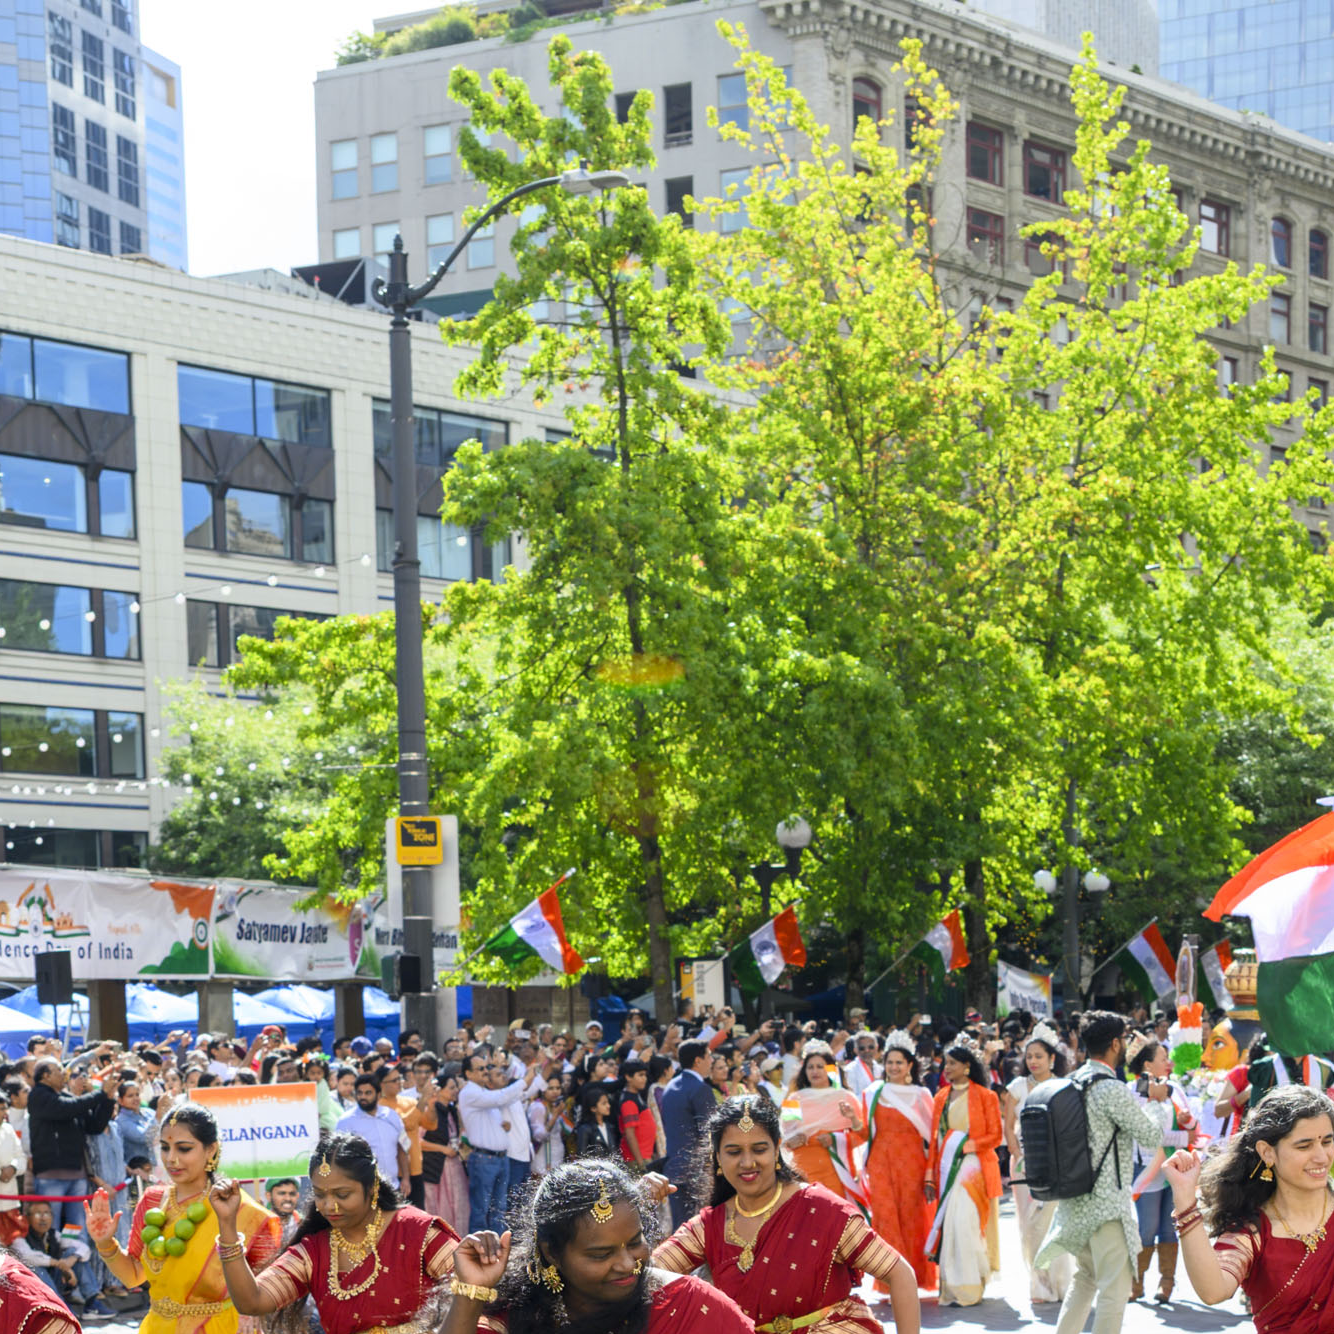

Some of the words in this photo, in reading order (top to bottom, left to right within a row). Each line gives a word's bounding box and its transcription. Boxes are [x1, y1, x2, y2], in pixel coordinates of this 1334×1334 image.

[236, 917, 297, 943] Satyamev
[78, 941, 92, 959] of
[99, 942, 133, 959] India
[220, 1124, 309, 1142] ELANGANA
